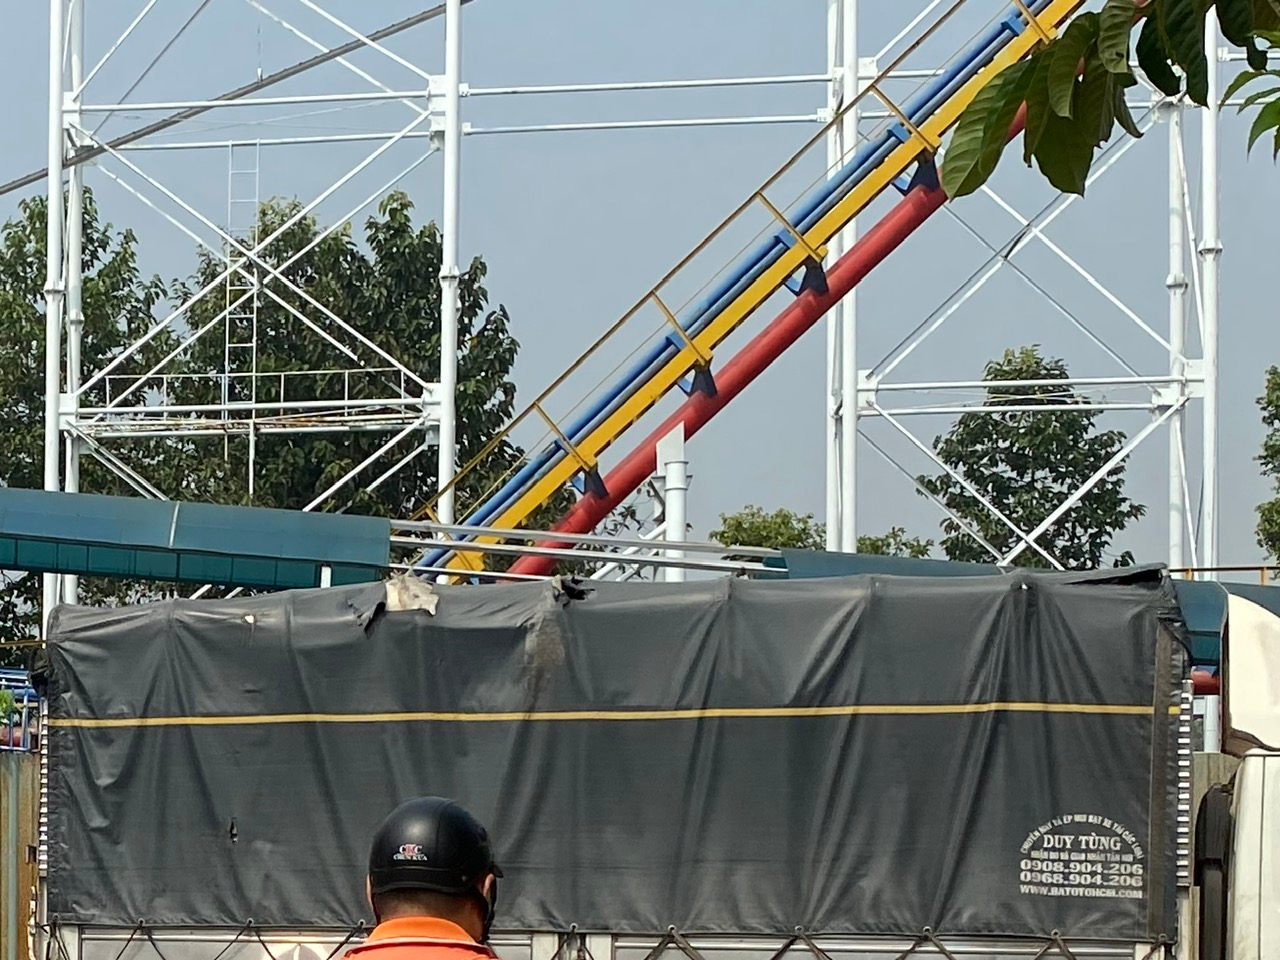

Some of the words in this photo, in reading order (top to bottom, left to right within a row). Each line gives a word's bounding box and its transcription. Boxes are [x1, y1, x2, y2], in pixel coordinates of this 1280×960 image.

[1043, 834, 1075, 849] DUY
[1078, 832, 1122, 851] TÙNG
[1019, 859, 1144, 875] 0908.904.206
[1019, 871, 1144, 887] 0968.904.206
